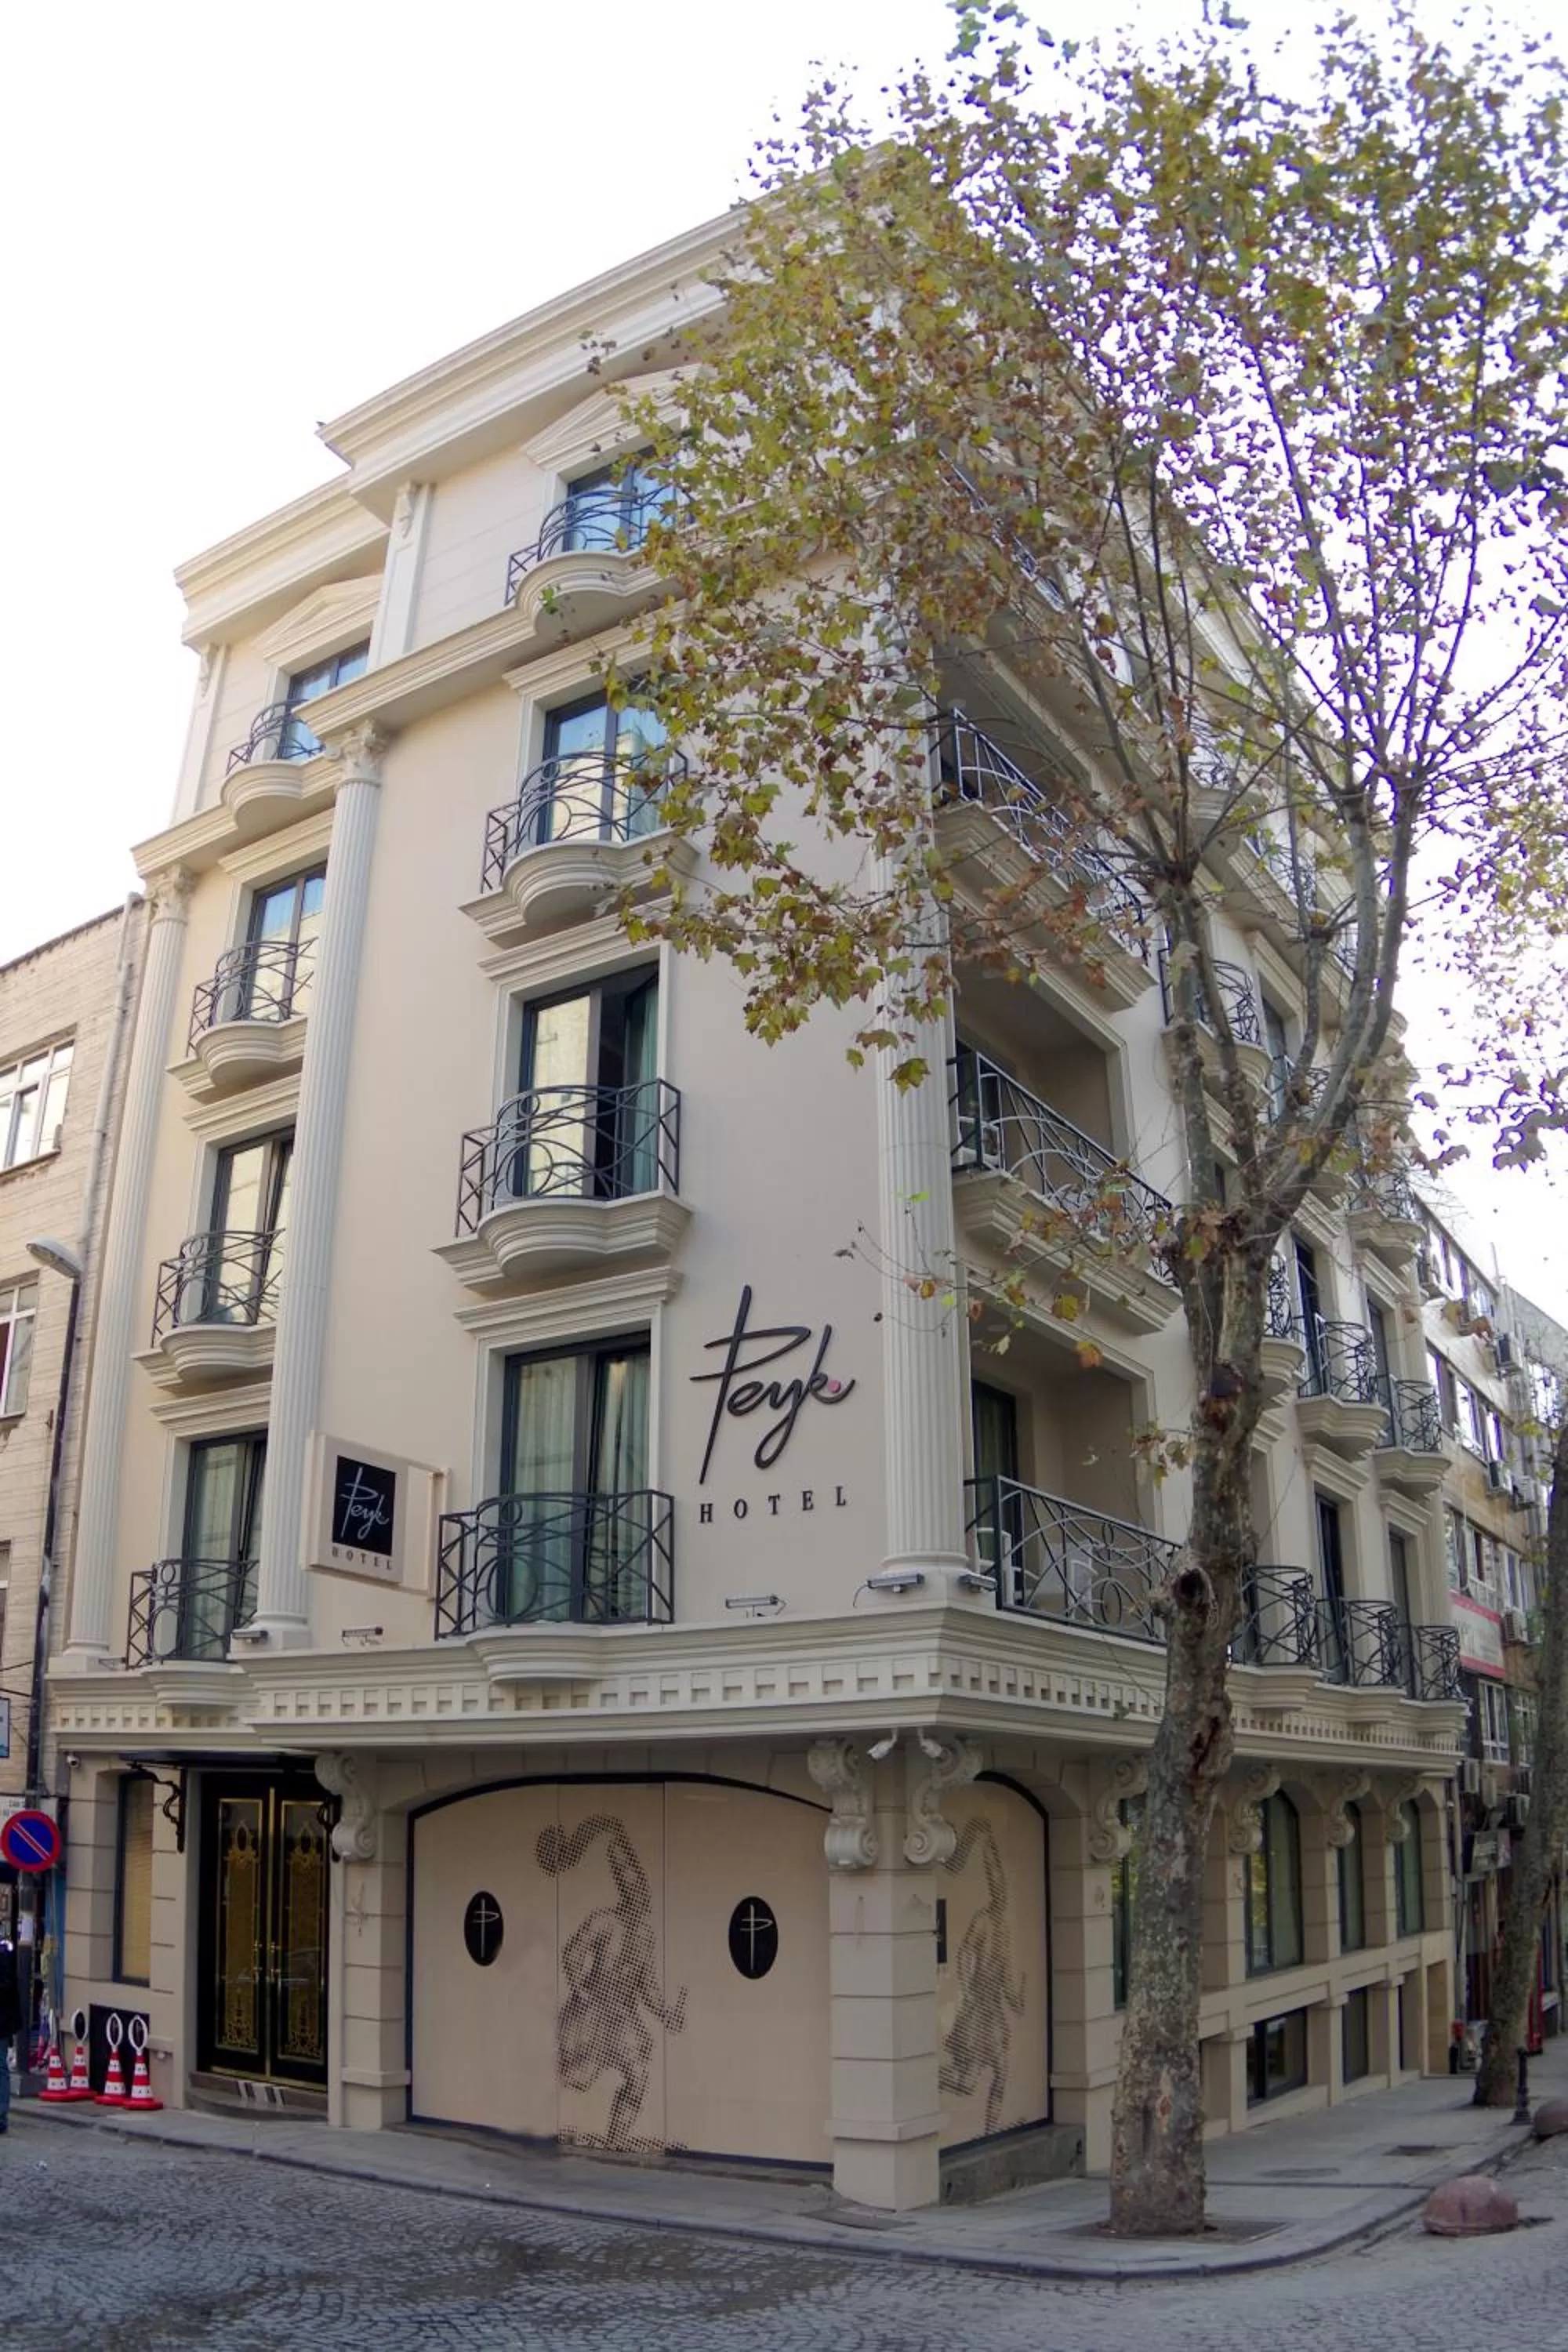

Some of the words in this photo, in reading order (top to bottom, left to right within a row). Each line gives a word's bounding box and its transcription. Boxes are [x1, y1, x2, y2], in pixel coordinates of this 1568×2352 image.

[690, 1284, 856, 1485] Peyk
[340, 1466, 390, 1540] Peyk
[699, 1486, 848, 1524] HOTEL
[332, 1545, 393, 1570] HOTEL
